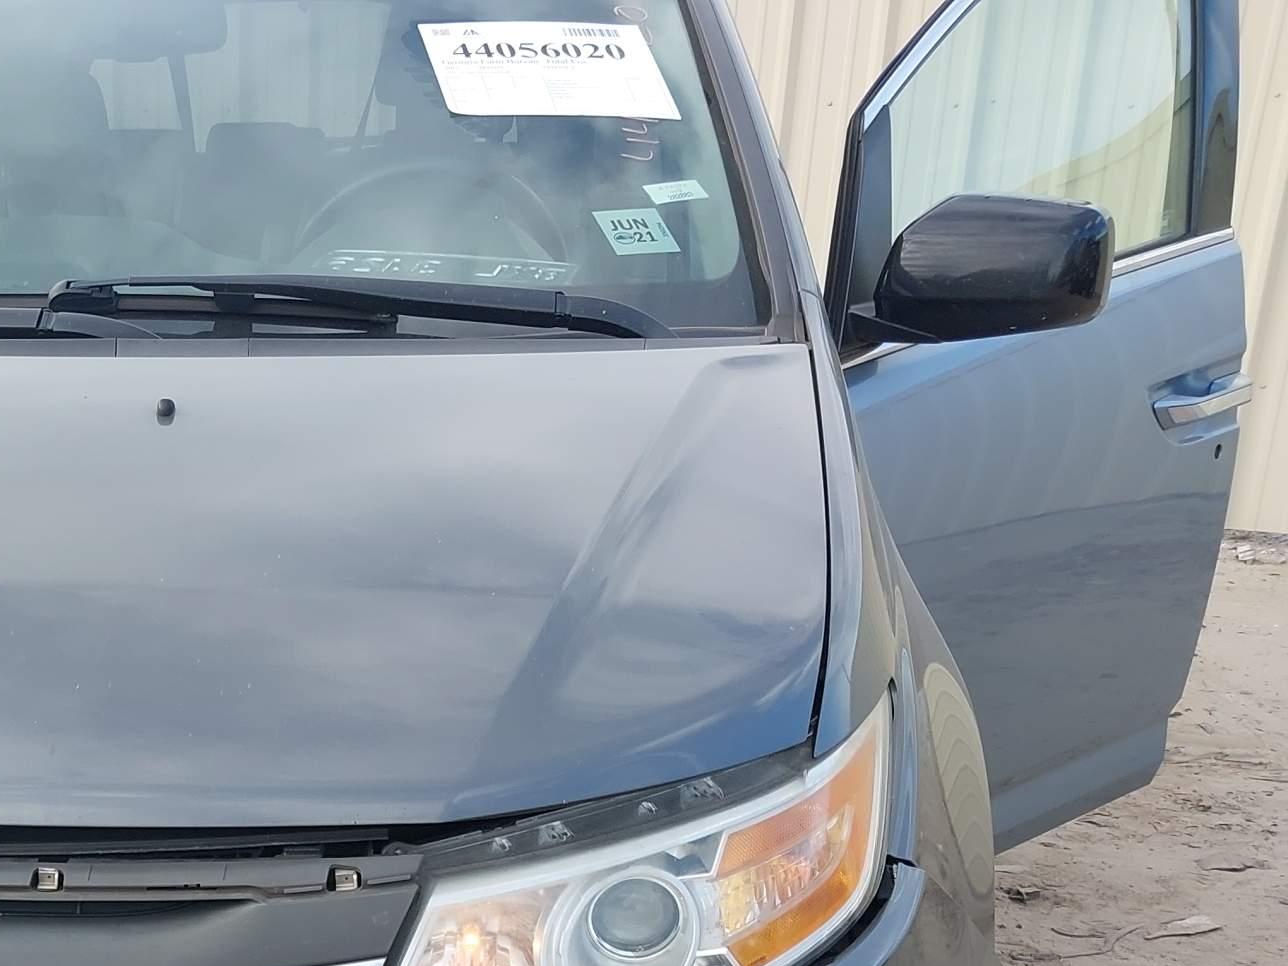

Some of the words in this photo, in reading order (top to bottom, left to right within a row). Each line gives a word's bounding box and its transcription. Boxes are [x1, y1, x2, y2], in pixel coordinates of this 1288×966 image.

[452, 42, 626, 61] 44056020
[610, 218, 649, 231] JUN
[633, 231, 659, 242] 21
